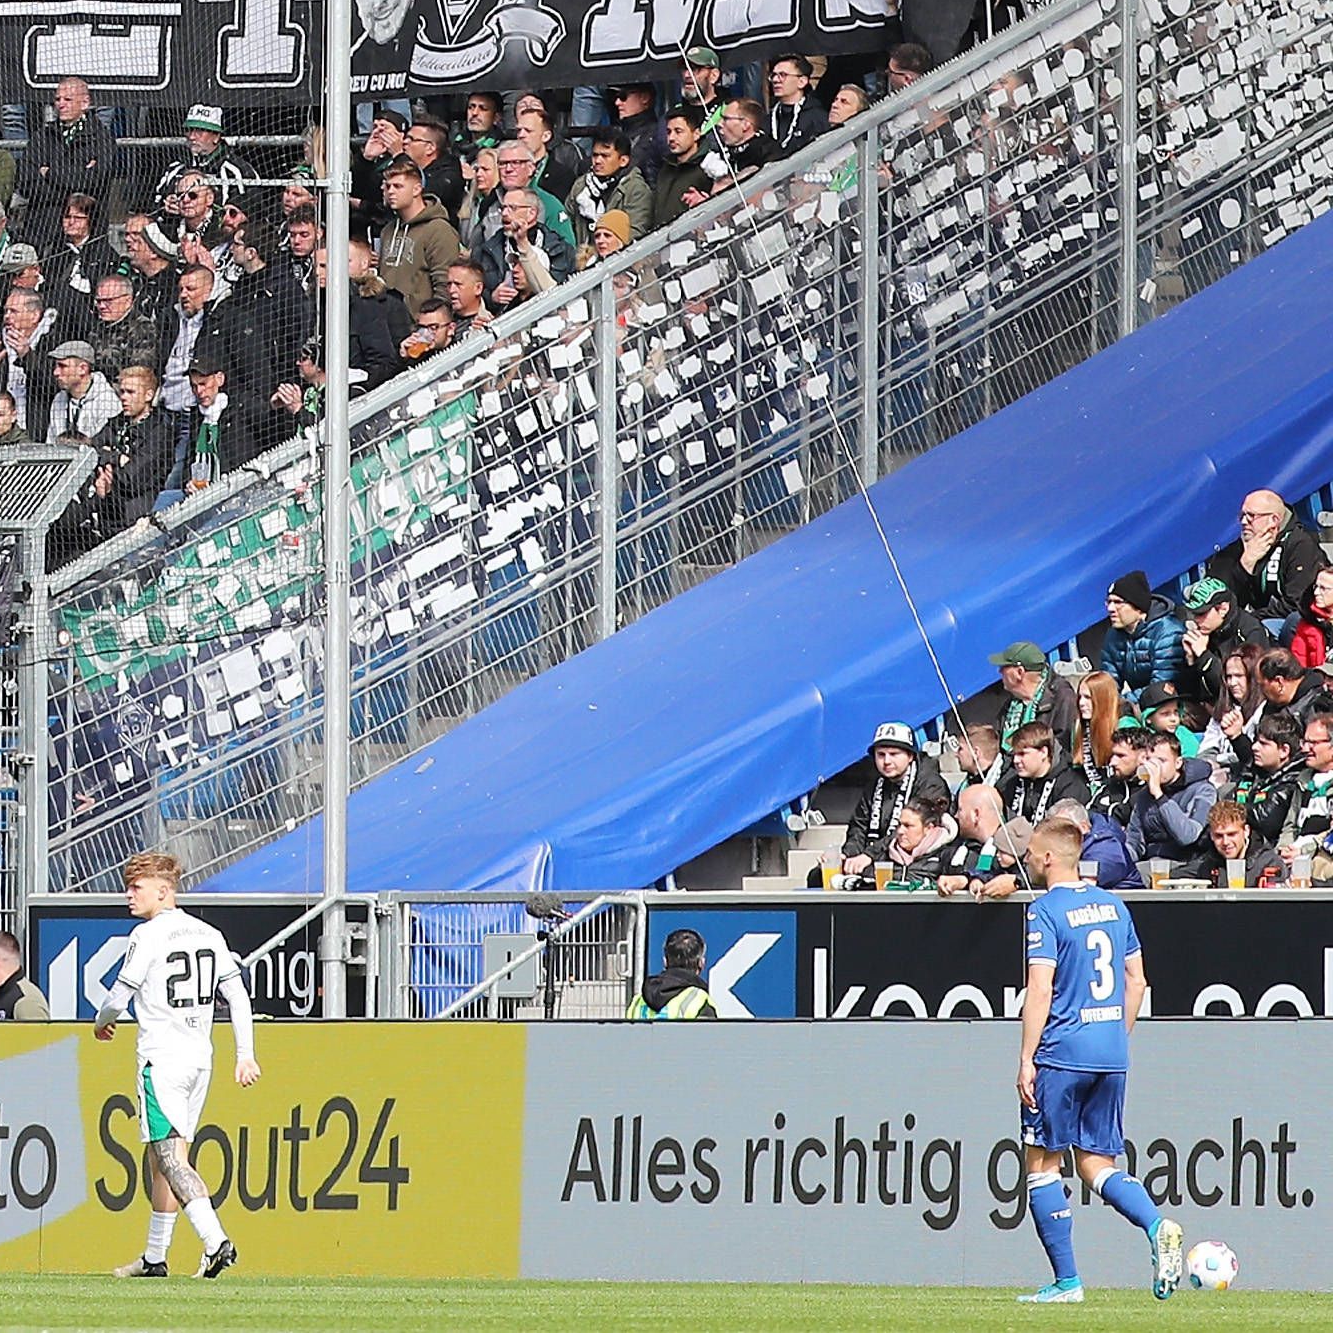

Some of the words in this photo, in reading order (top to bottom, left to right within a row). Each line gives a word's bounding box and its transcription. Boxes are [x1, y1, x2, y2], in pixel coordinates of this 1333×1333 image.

[165, 948, 217, 1010] 20
[1085, 929, 1116, 1003] 3
[561, 1116, 721, 1206] Alles
[744, 1113, 962, 1231] richtig
